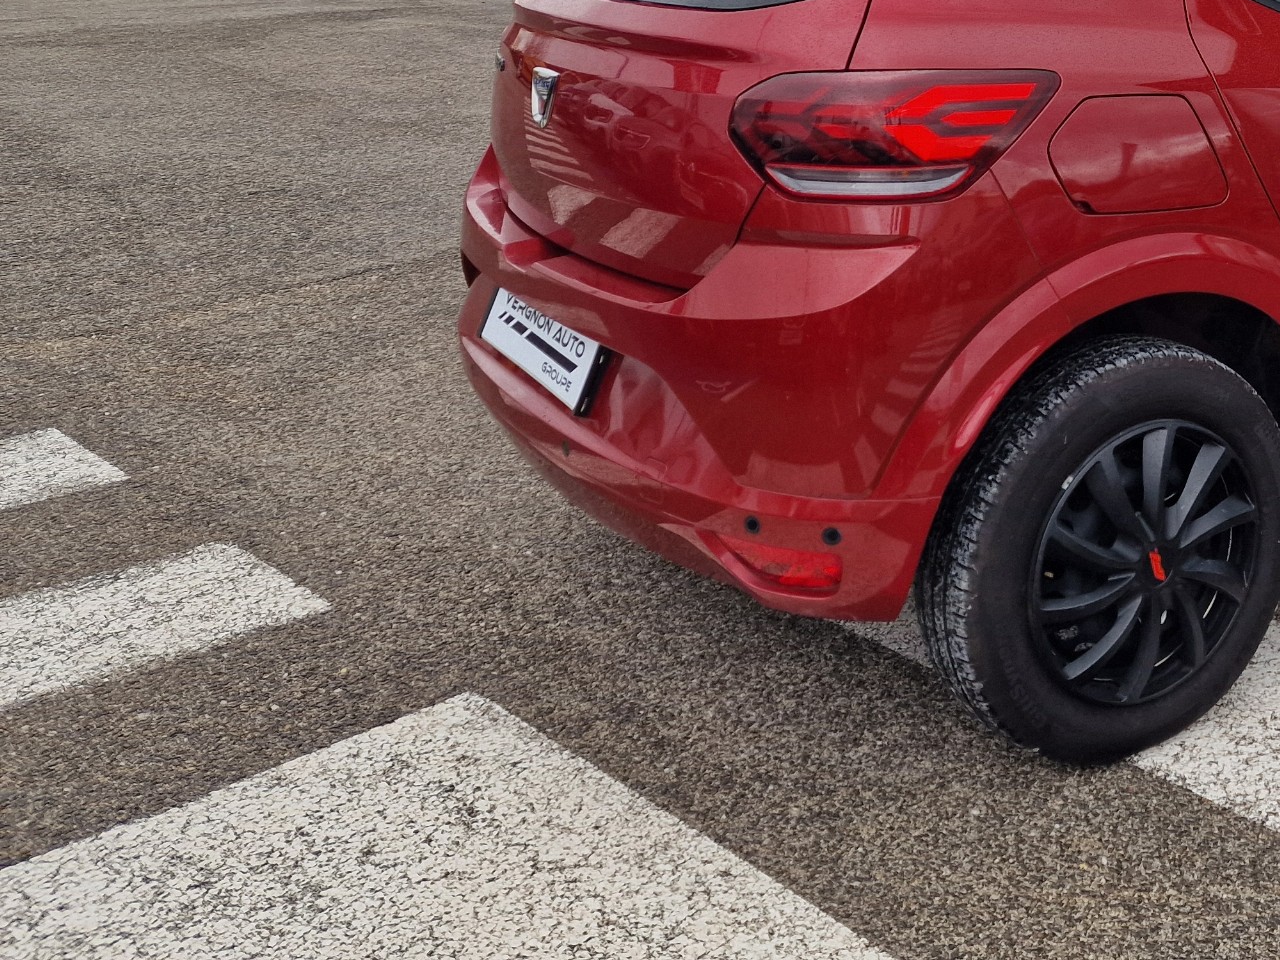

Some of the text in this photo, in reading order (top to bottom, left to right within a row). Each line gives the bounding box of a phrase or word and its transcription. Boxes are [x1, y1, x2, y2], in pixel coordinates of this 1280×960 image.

[506, 292, 586, 358] VERGNON AUTO
[541, 361, 573, 393] GROUPE
